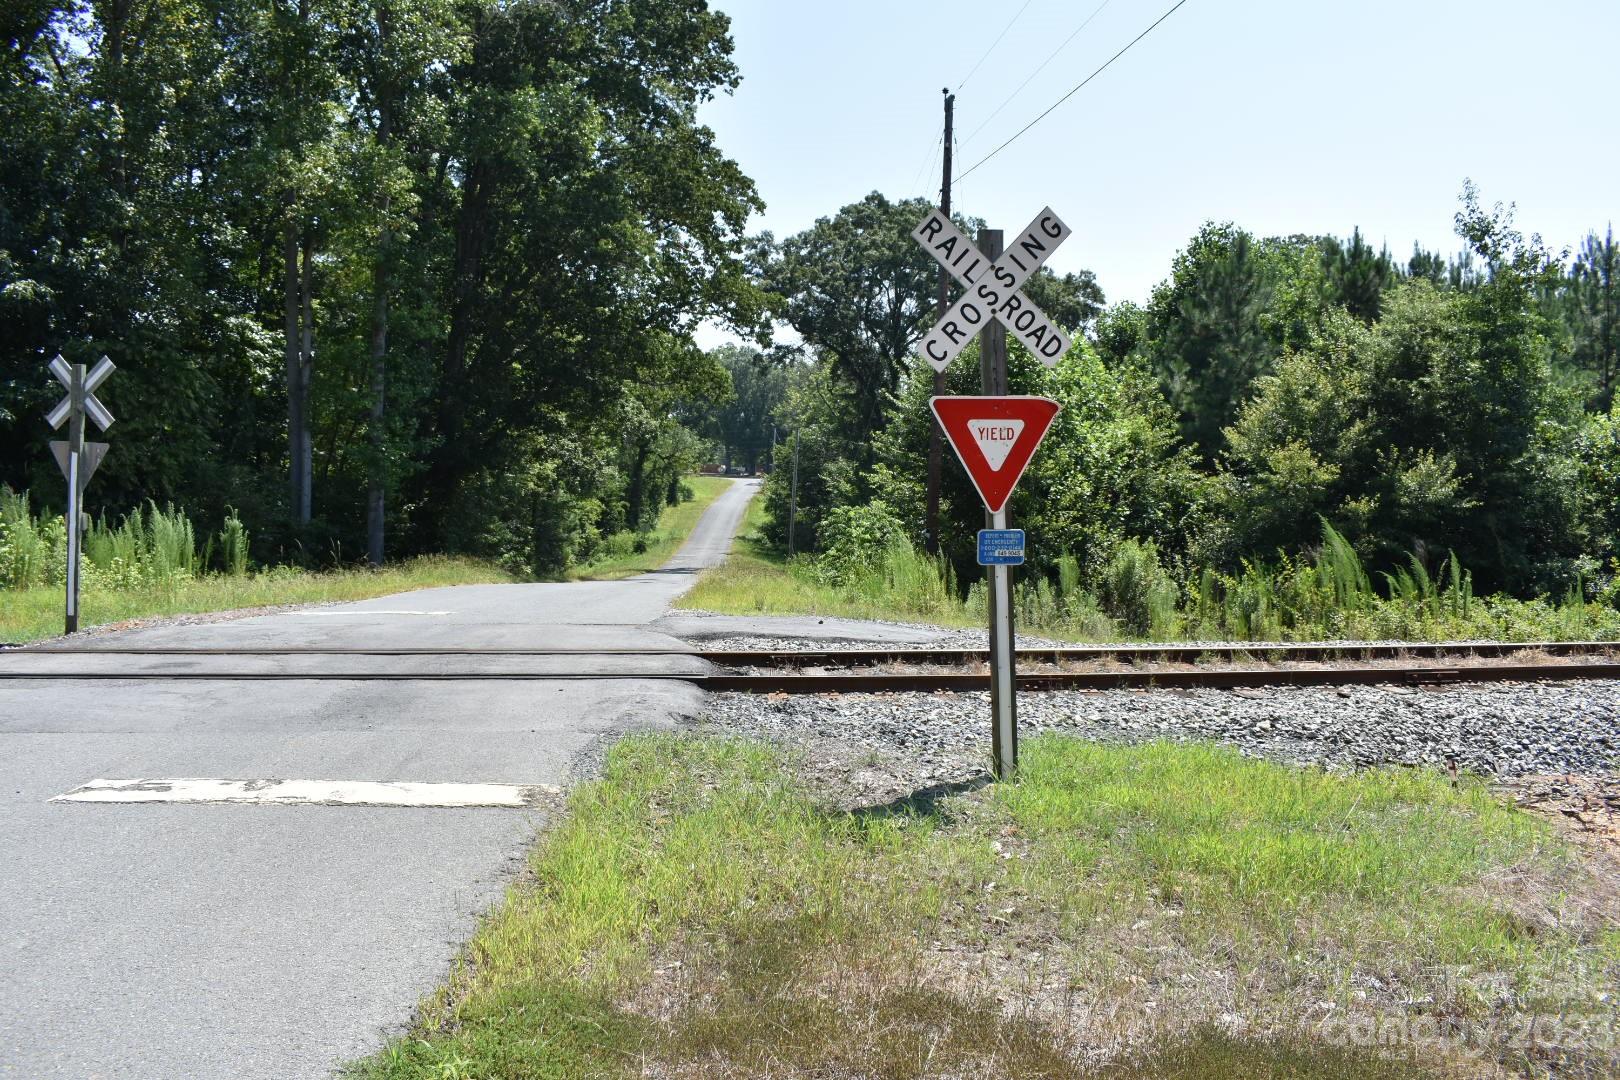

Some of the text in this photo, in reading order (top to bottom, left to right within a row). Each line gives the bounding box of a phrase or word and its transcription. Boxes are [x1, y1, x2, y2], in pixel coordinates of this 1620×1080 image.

[920, 216, 1062, 358] RAIL ROAD
[926, 216, 1062, 362] CROSSING
[977, 427, 1015, 441] YIELD
